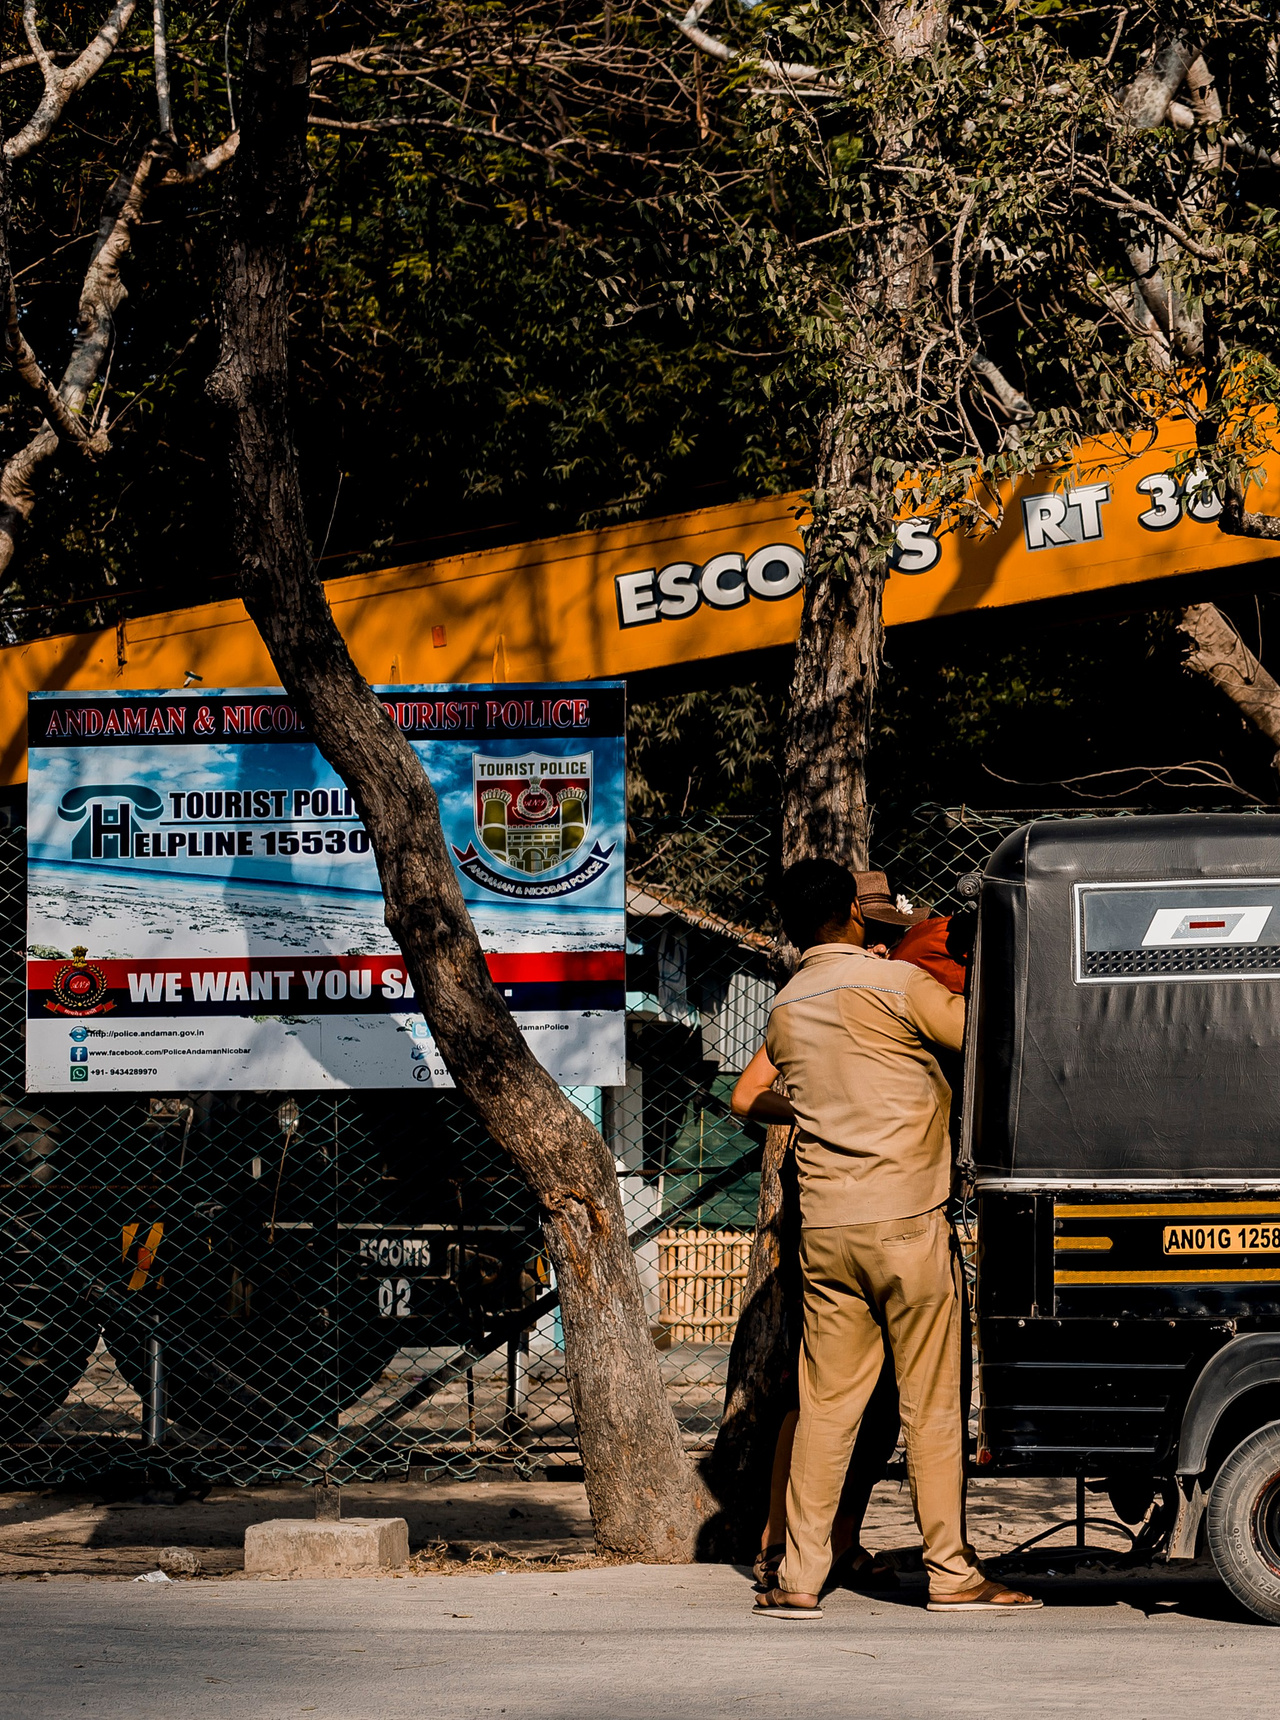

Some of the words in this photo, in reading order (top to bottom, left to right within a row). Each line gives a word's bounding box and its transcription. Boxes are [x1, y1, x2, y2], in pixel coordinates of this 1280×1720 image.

[615, 516, 942, 629] ESCOS
[1023, 482, 1109, 551] RT
[46, 707, 187, 738] ANDAMAN
[193, 705, 216, 736] &
[222, 704, 307, 735] NICO
[486, 699, 591, 729] POLICE
[479, 762, 535, 777] TOURIST
[540, 761, 588, 775] POLICE
[168, 789, 289, 820] TOURIST
[292, 787, 359, 818] POLI
[466, 864, 516, 894] ANDAMAN
[523, 881, 571, 896] NICOBAR
[570, 860, 604, 887] POLICE
[127, 972, 183, 1003] WE
[190, 971, 295, 1002] WANT
[302, 969, 372, 1000] YOU
[519, 1023, 570, 1031] damanPolice
[89, 1048, 252, 1057] www.facebook.com/PoliceAndamanNicobar
[110, 1068, 158, 1076] 9434289970
[360, 1238, 431, 1268] ESCORTS
[1168, 1228, 1231, 1250] AN01G
[378, 1278, 411, 1317] 02
